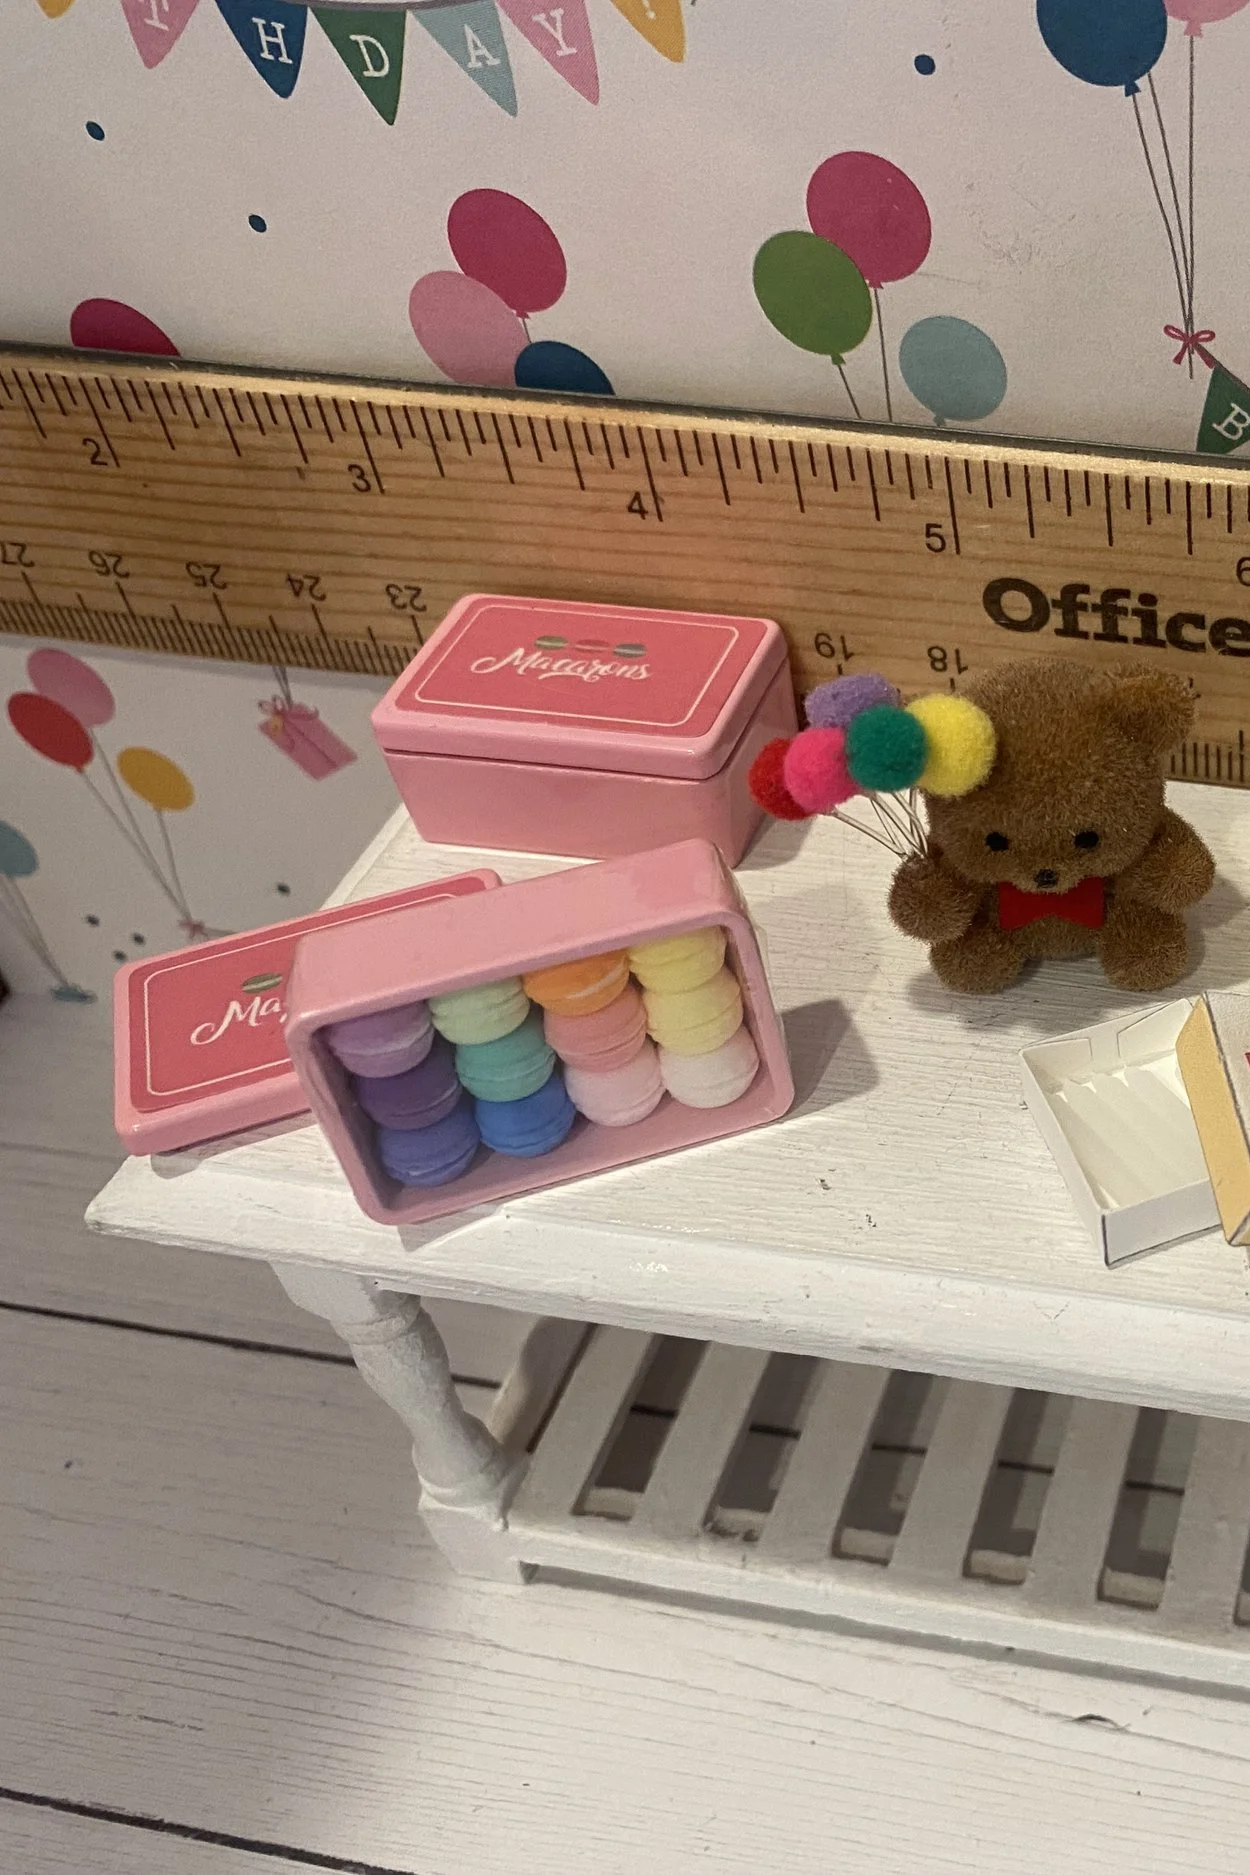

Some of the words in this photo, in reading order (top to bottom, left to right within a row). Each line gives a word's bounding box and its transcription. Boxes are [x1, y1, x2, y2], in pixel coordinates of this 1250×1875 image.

[82, 438, 108, 466] 2
[347, 464, 371, 493] 3
[627, 492, 648, 521] 4
[925, 524, 946, 553] 5
[0, 541, 35, 568] 27
[88, 550, 130, 579] 26
[185, 561, 227, 590] 25
[287, 574, 327, 601] 24
[385, 583, 427, 613] 23
[814, 632, 855, 662] 19
[927, 645, 969, 676] 18
[470, 647, 653, 683] Macarons
[190, 996, 288, 1045] Ma
